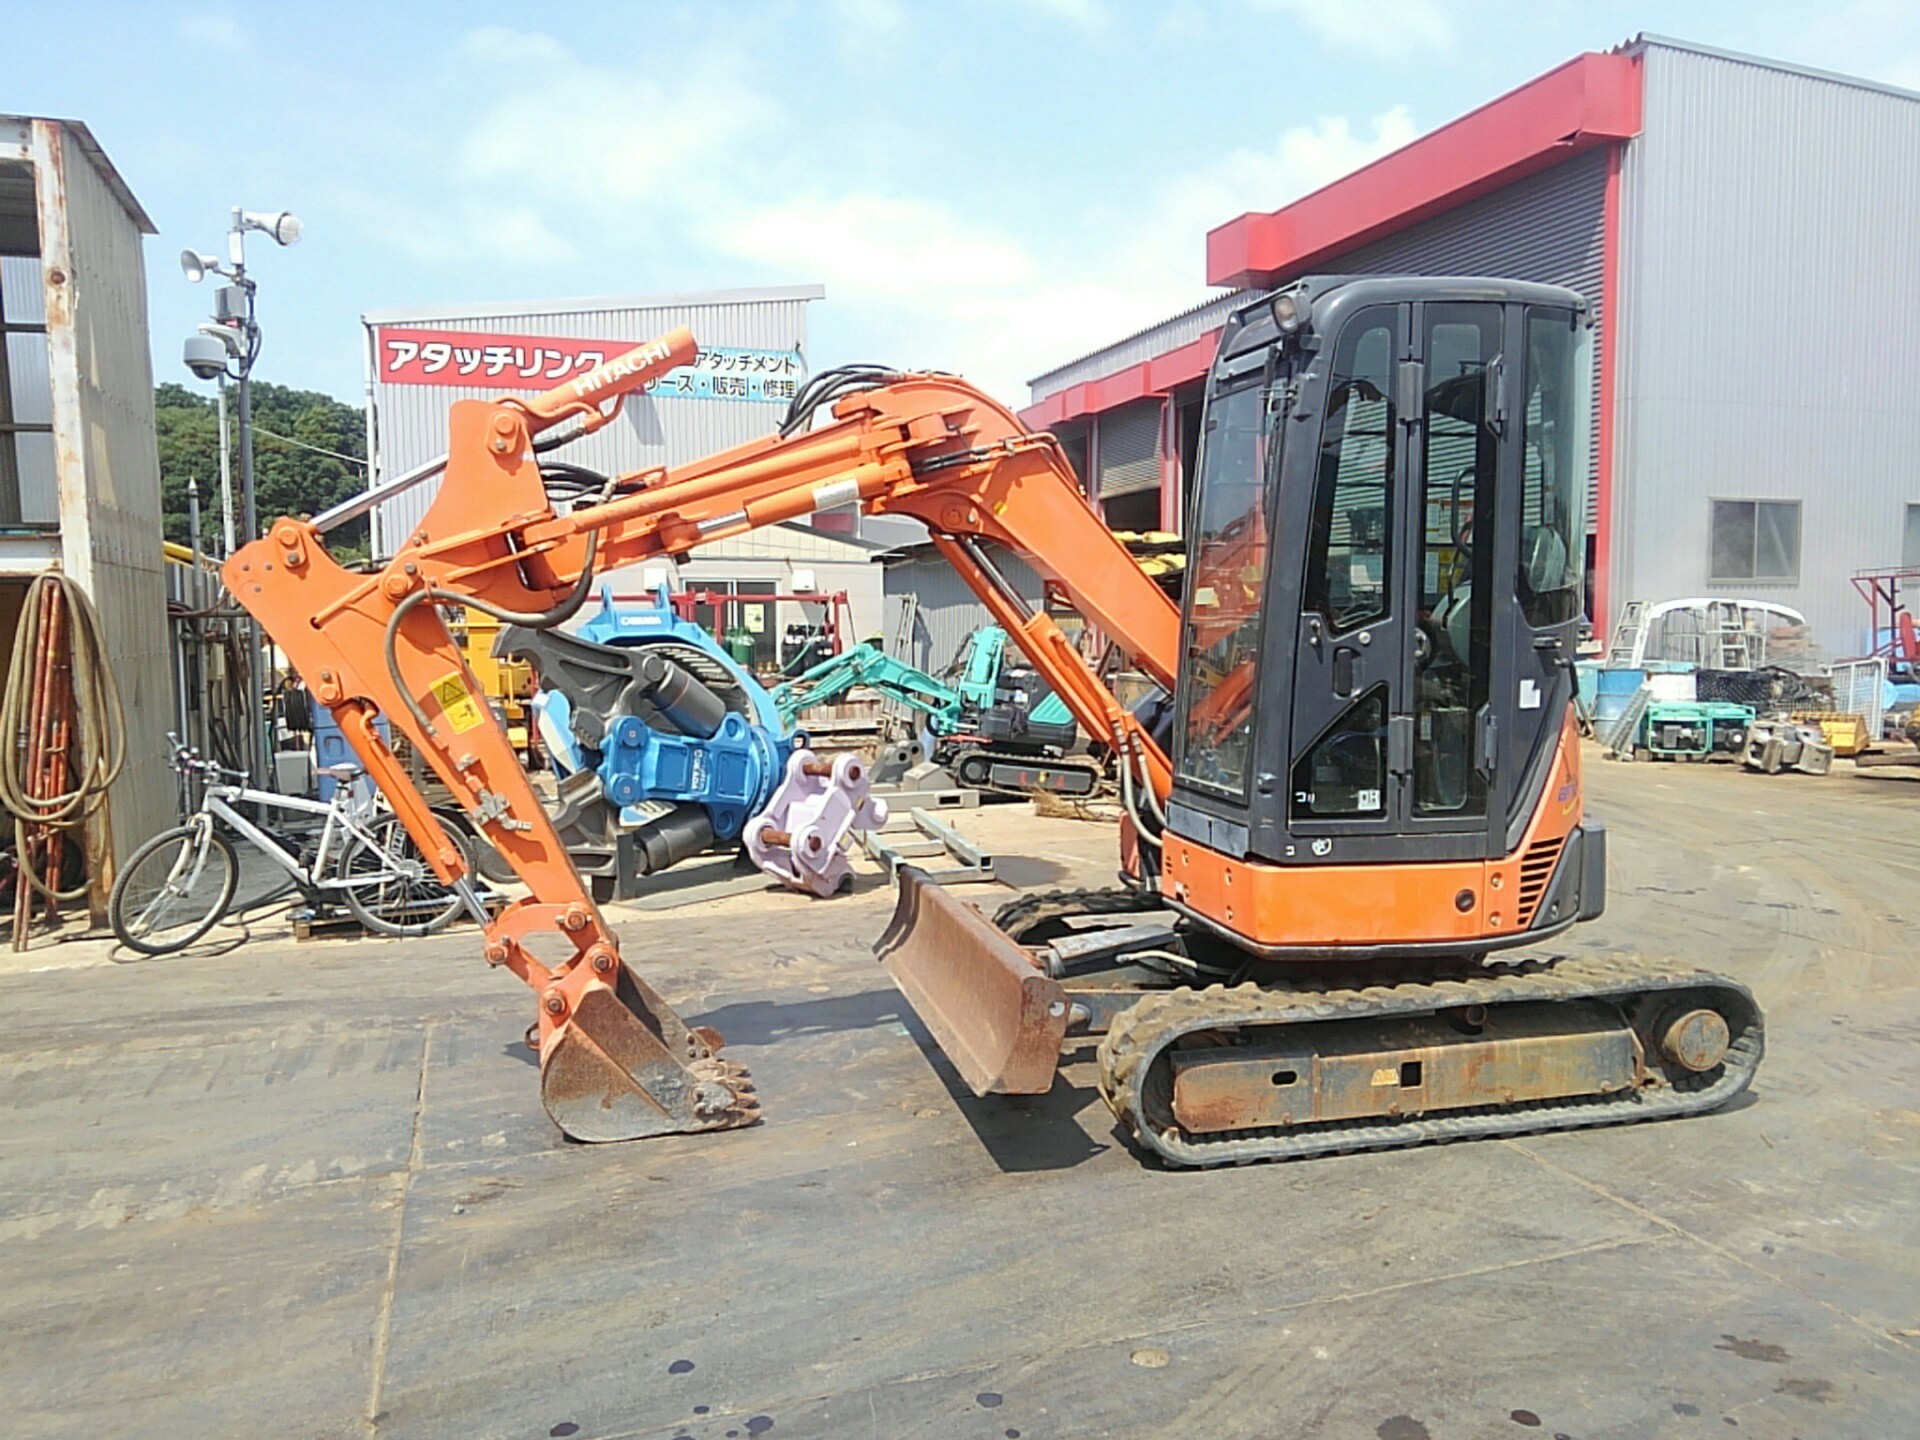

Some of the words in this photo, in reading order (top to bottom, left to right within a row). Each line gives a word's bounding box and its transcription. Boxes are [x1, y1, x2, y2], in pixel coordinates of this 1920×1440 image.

[573, 340, 671, 397] HITACHI
[694, 351, 796, 375] アタッチメント
